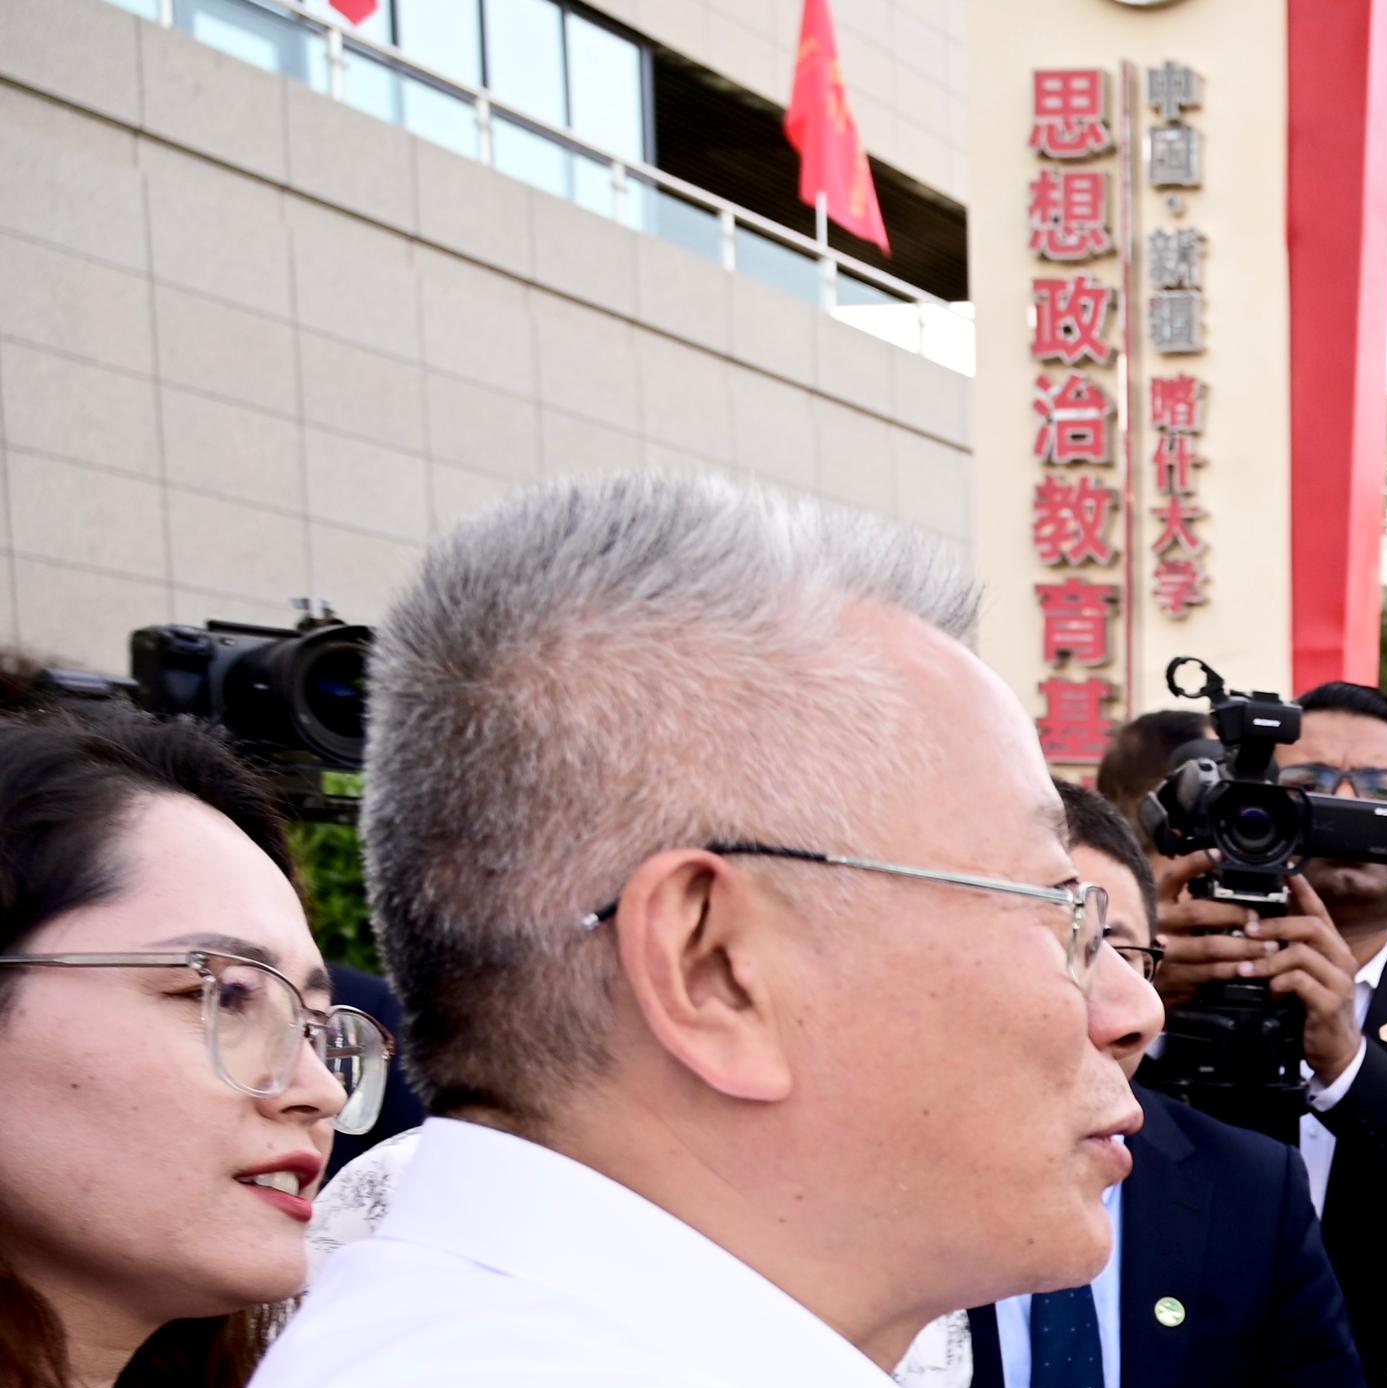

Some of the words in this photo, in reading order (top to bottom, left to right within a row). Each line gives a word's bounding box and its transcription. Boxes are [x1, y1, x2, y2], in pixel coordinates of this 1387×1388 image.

[1029, 67, 1114, 790] 思想政治教育基
